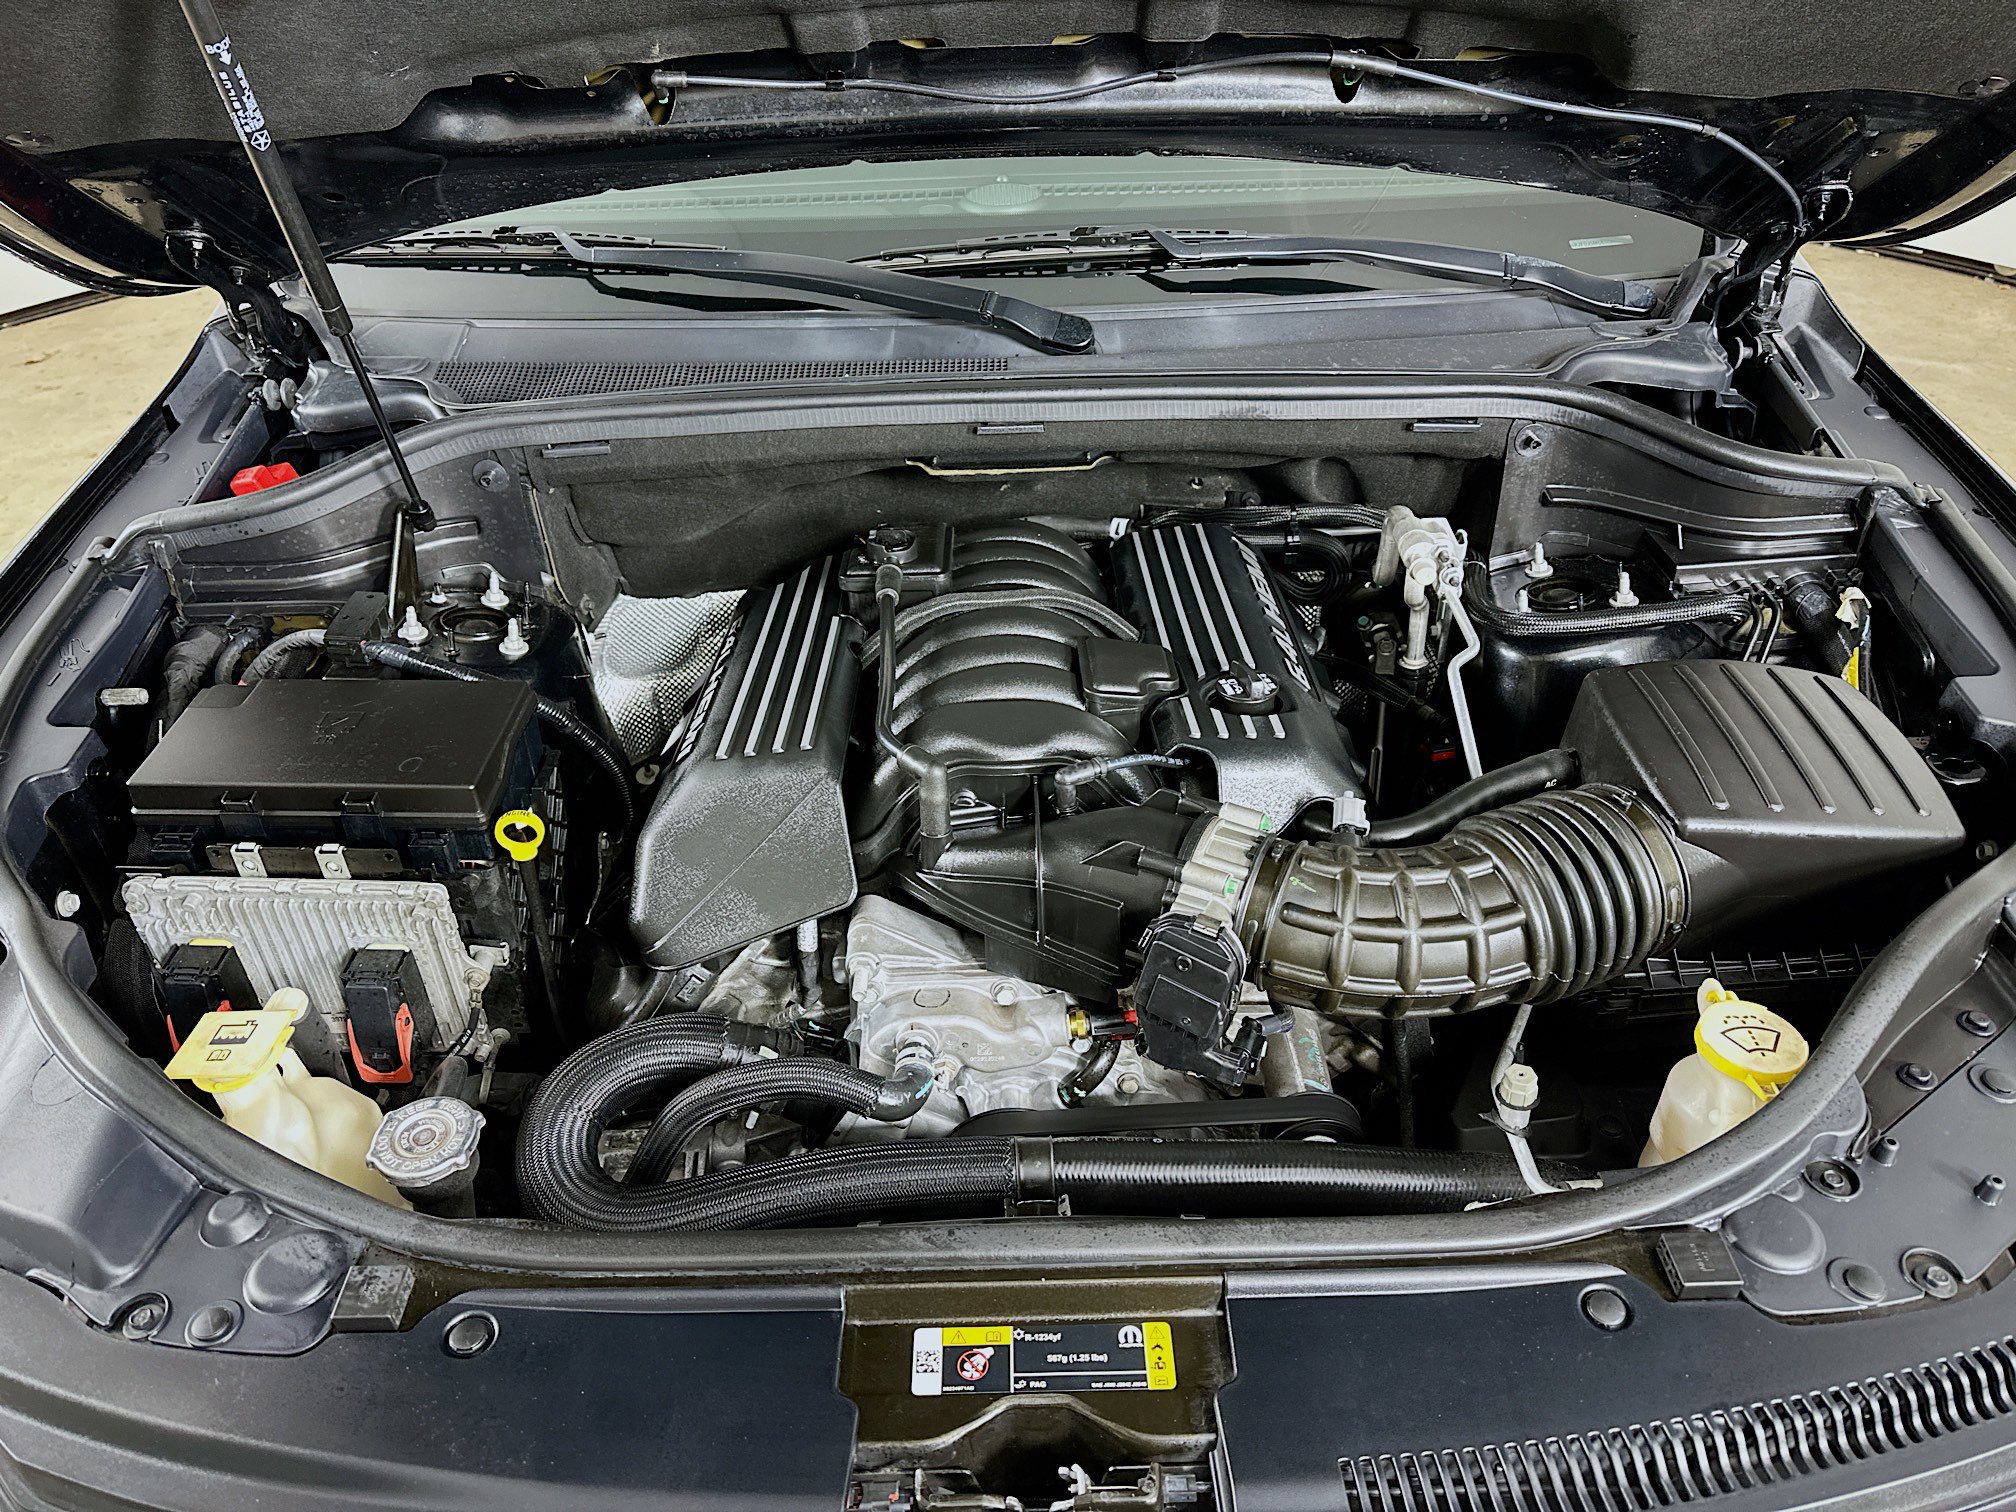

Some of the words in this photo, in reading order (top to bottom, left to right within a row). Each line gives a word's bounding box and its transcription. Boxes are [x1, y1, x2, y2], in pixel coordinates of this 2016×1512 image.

[1231, 535, 1287, 631] HEMI
[676, 665, 725, 763] HEMI
[397, 1101, 433, 1120] KEEP
[403, 1156, 439, 1170] OPEN
[441, 1134, 465, 1157] HOT
[1024, 1332, 1062, 1342] R-1234yf
[1069, 1353, 1091, 1364] (1.25
[1029, 1380, 1047, 1389] PAG
